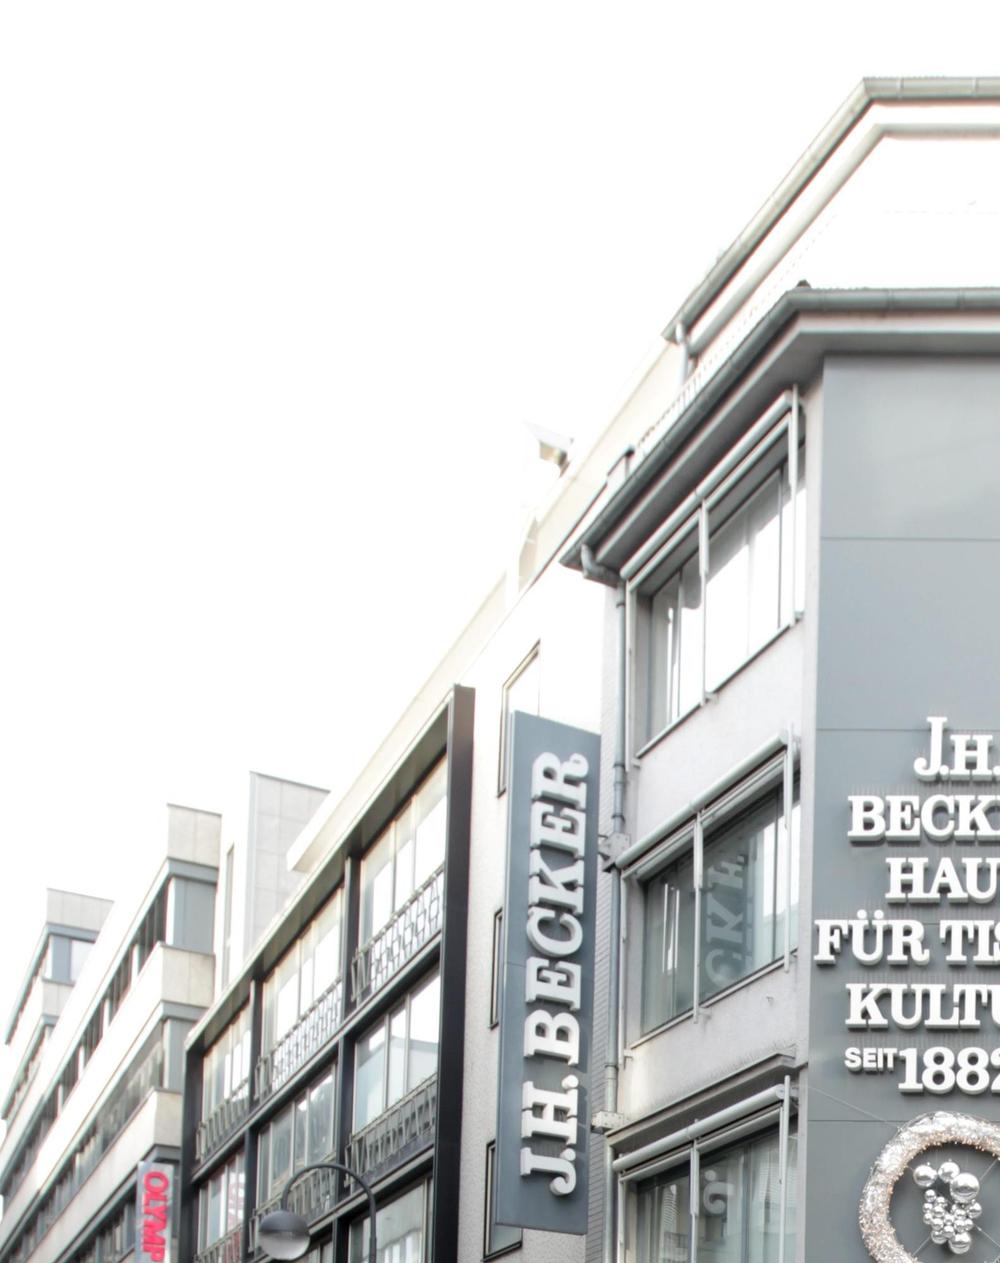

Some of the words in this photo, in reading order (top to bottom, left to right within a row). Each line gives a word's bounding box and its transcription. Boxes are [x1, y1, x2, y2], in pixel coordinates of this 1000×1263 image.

[523, 751, 589, 1067] BECKER
[813, 909, 930, 966] FÜR
[844, 1047, 898, 1072] SEIT
[520, 1074, 580, 1197] J.H.
[143, 1170, 170, 1263] OLYMP
